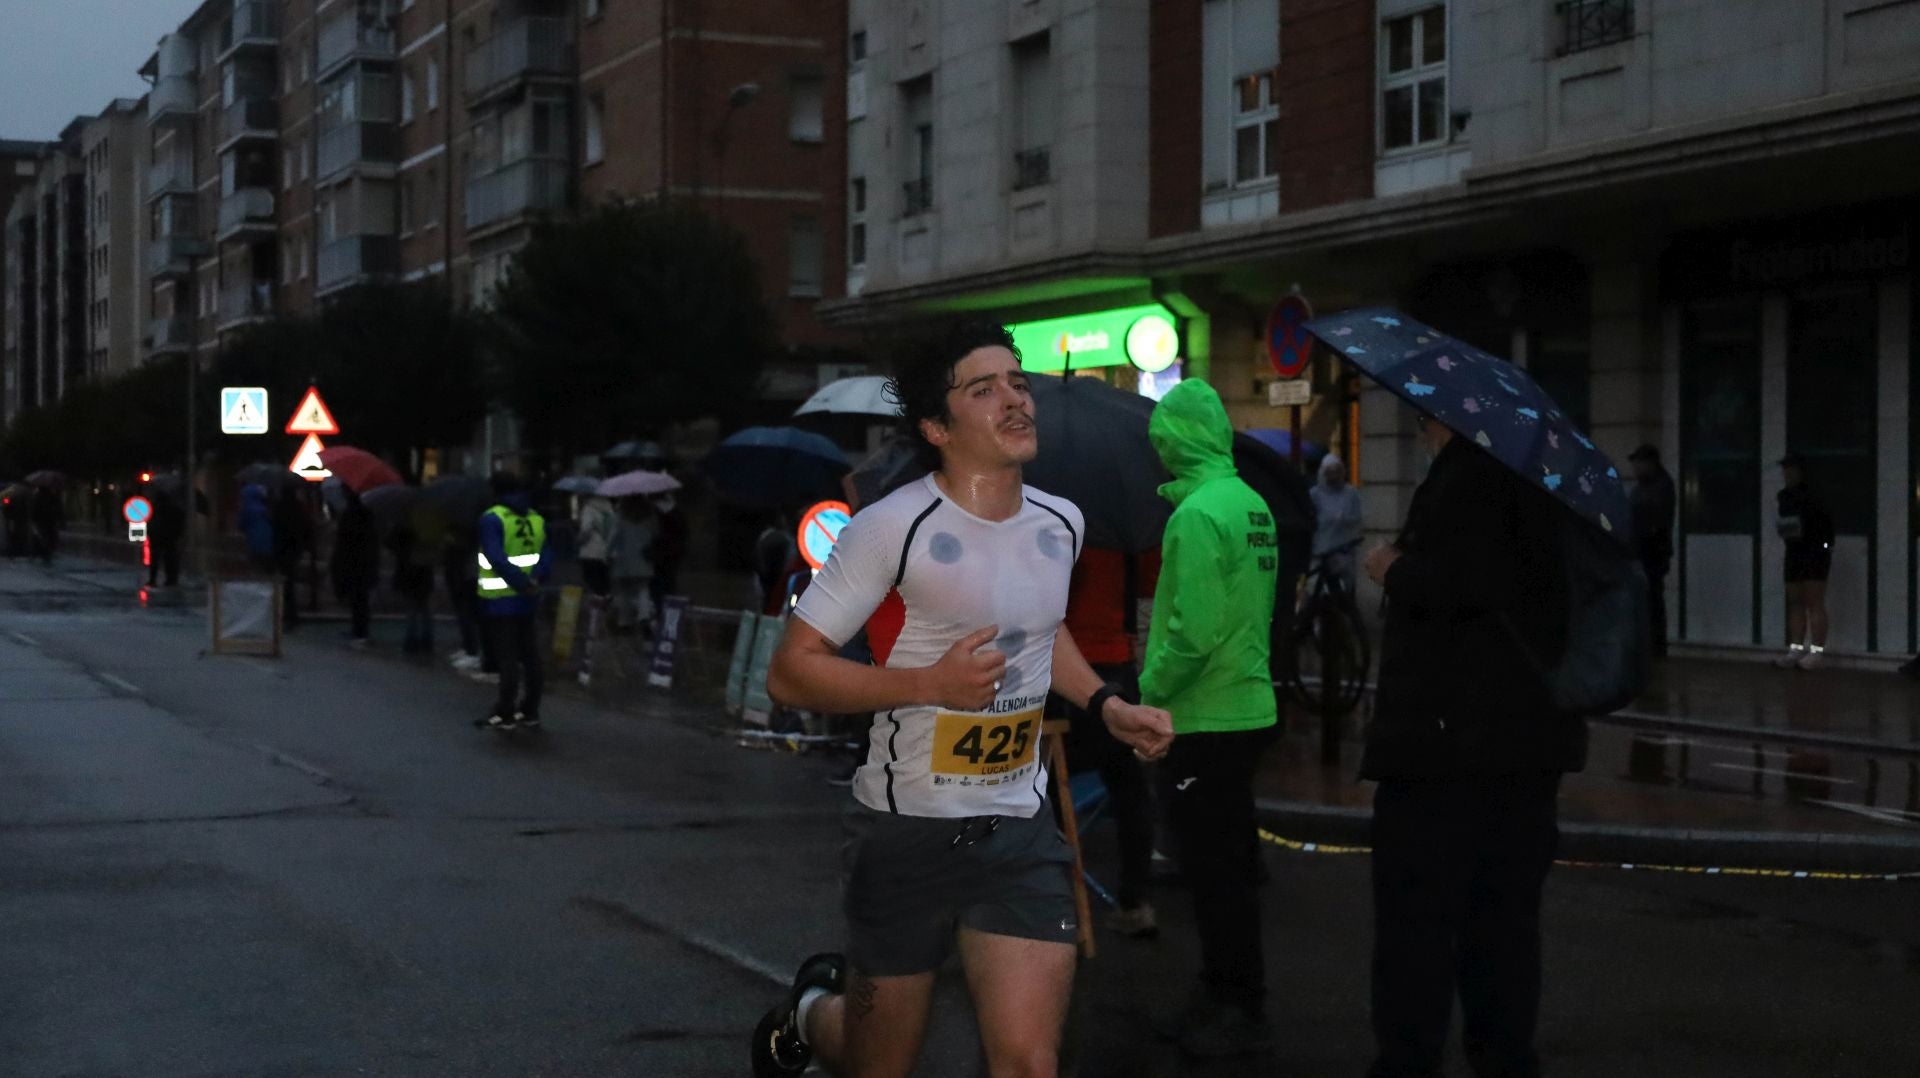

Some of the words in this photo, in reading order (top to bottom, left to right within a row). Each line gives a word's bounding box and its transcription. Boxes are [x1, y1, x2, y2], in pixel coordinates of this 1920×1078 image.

[982, 696, 1028, 713] ALENCIA
[953, 720, 1031, 764] 425
[981, 765, 1010, 775] LUCAS
